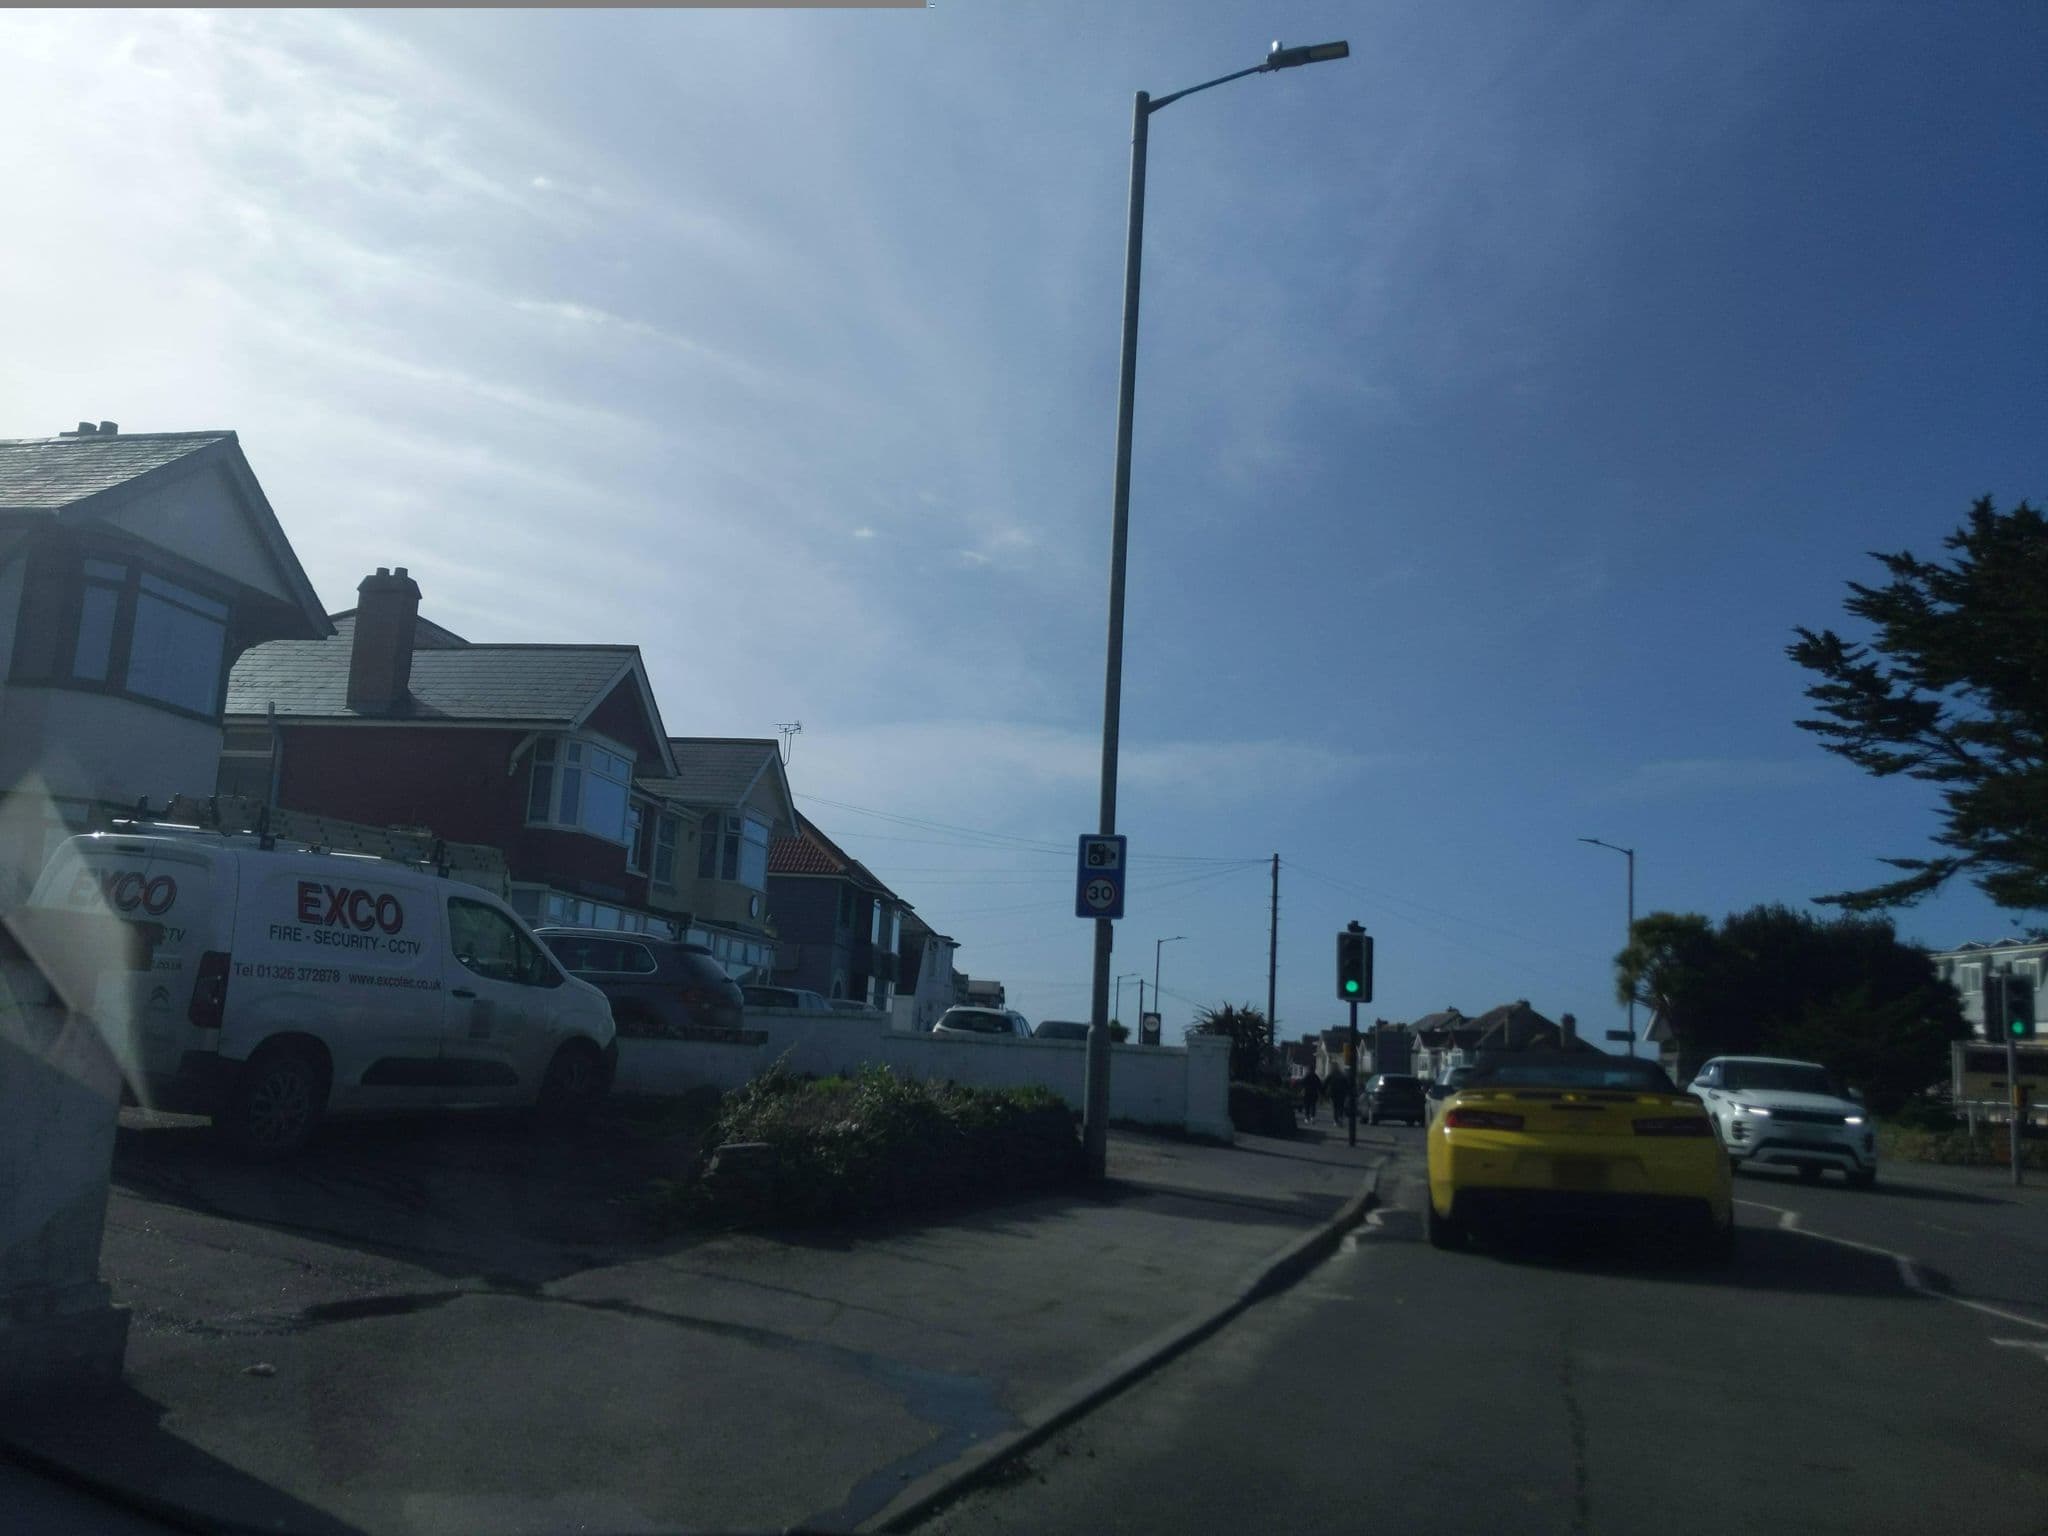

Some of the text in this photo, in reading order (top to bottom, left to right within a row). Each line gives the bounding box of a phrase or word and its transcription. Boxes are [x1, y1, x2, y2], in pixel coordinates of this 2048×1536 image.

[1088, 886, 1113, 901] 30
[296, 880, 404, 935] EXCO
[269, 924, 302, 942] FIRE
[312, 929, 379, 951] SECURITY
[388, 938, 421, 957] CCTV
[233, 962, 253, 977] Tel
[256, 964, 295, 980] 01326
[297, 967, 341, 983] 372878
